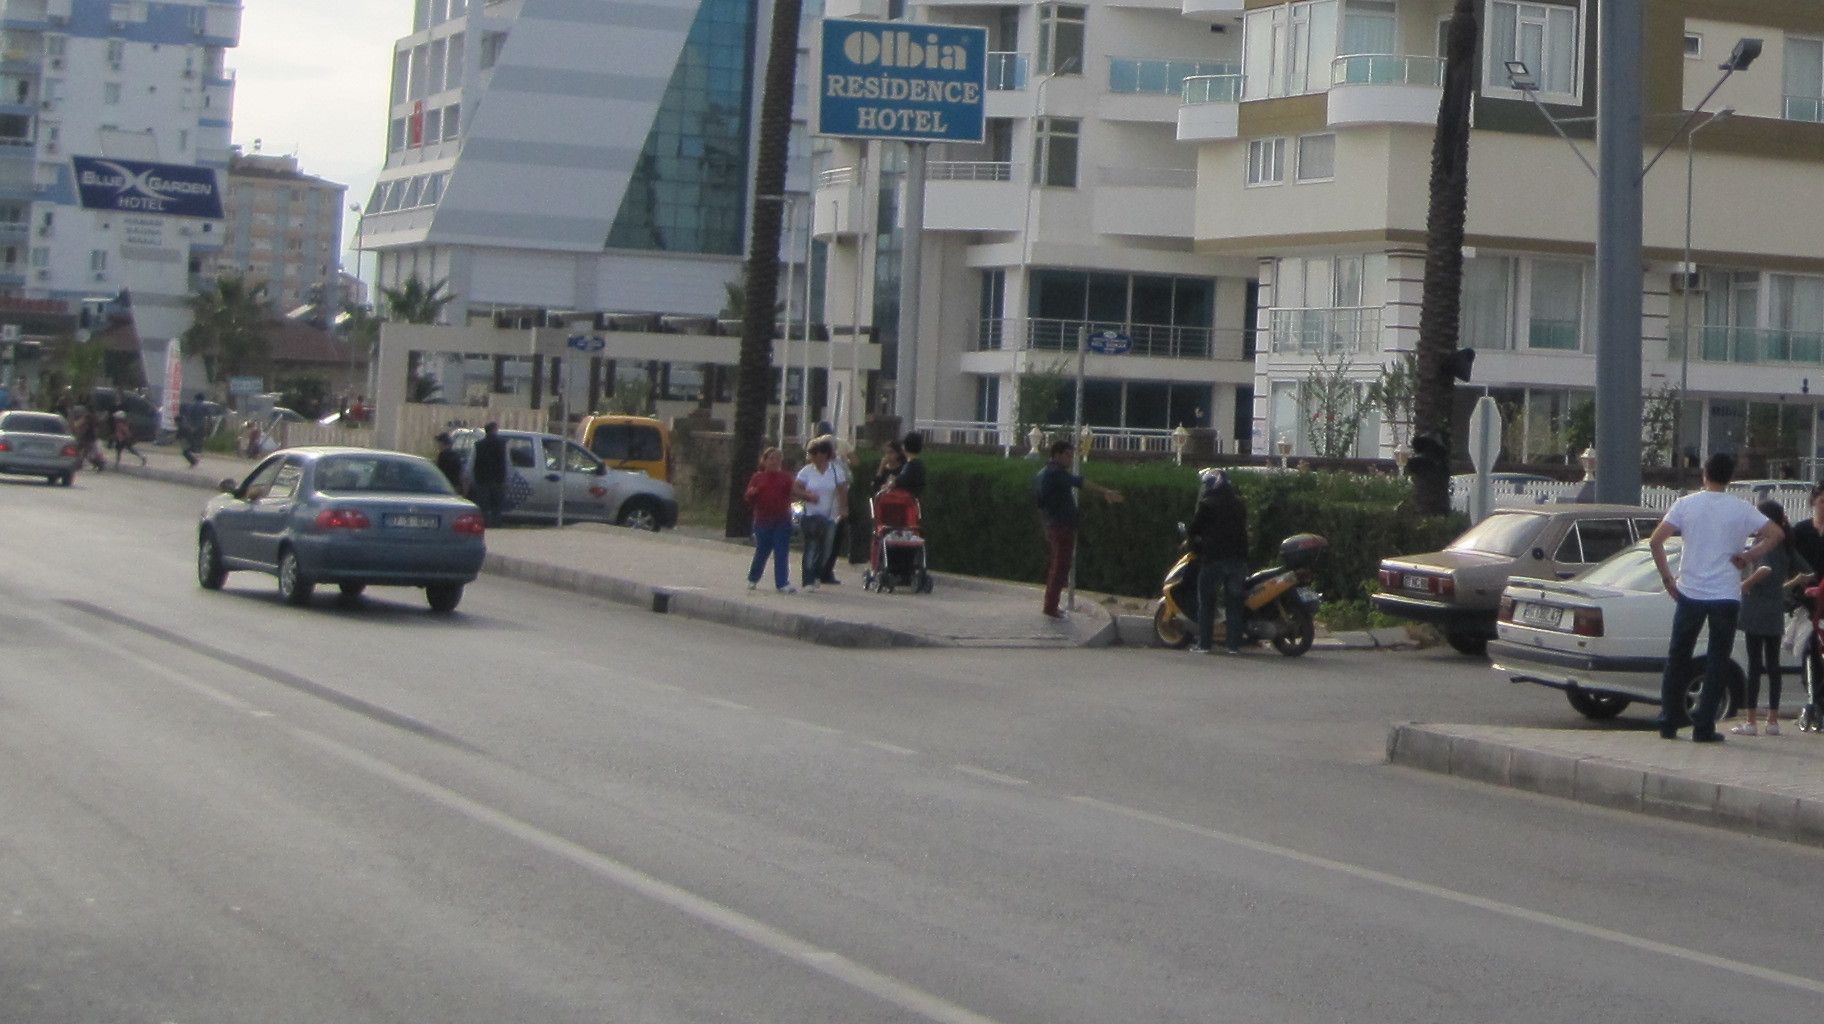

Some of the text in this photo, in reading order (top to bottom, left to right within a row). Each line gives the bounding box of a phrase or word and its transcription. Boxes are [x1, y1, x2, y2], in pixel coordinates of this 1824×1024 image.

[843, 30, 968, 71] Olbia
[826, 73, 980, 104] RESİDENCE
[857, 106, 949, 133] HOTEL
[119, 196, 168, 211] HOTEL
